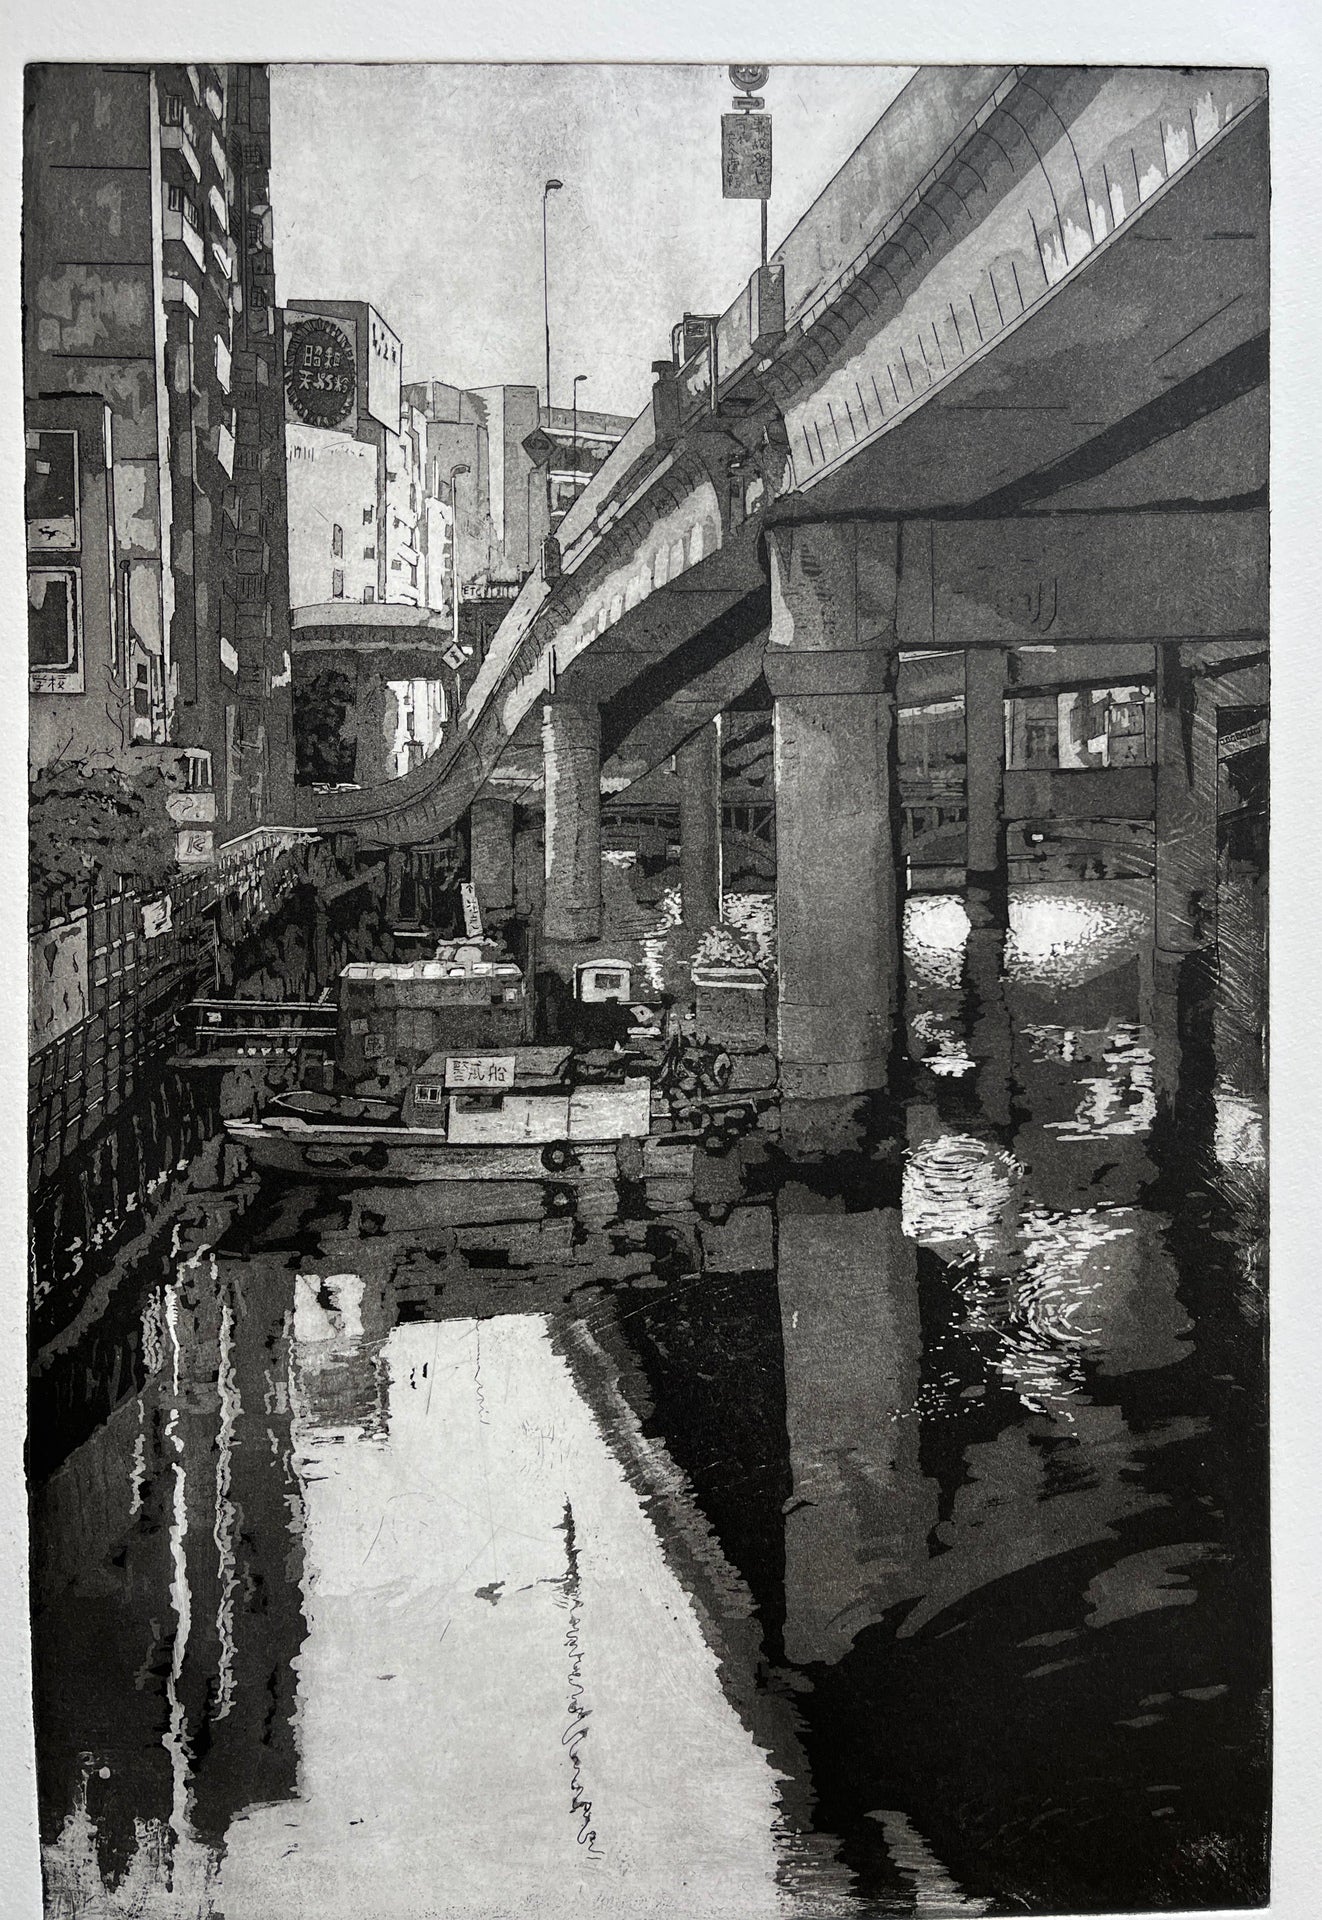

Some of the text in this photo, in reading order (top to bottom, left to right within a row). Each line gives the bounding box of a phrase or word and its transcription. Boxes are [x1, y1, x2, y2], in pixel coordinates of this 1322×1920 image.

[304, 345, 341, 369] 昭和
[299, 369, 350, 394] 天ぷら粉
[32, 674, 67, 691] 学校
